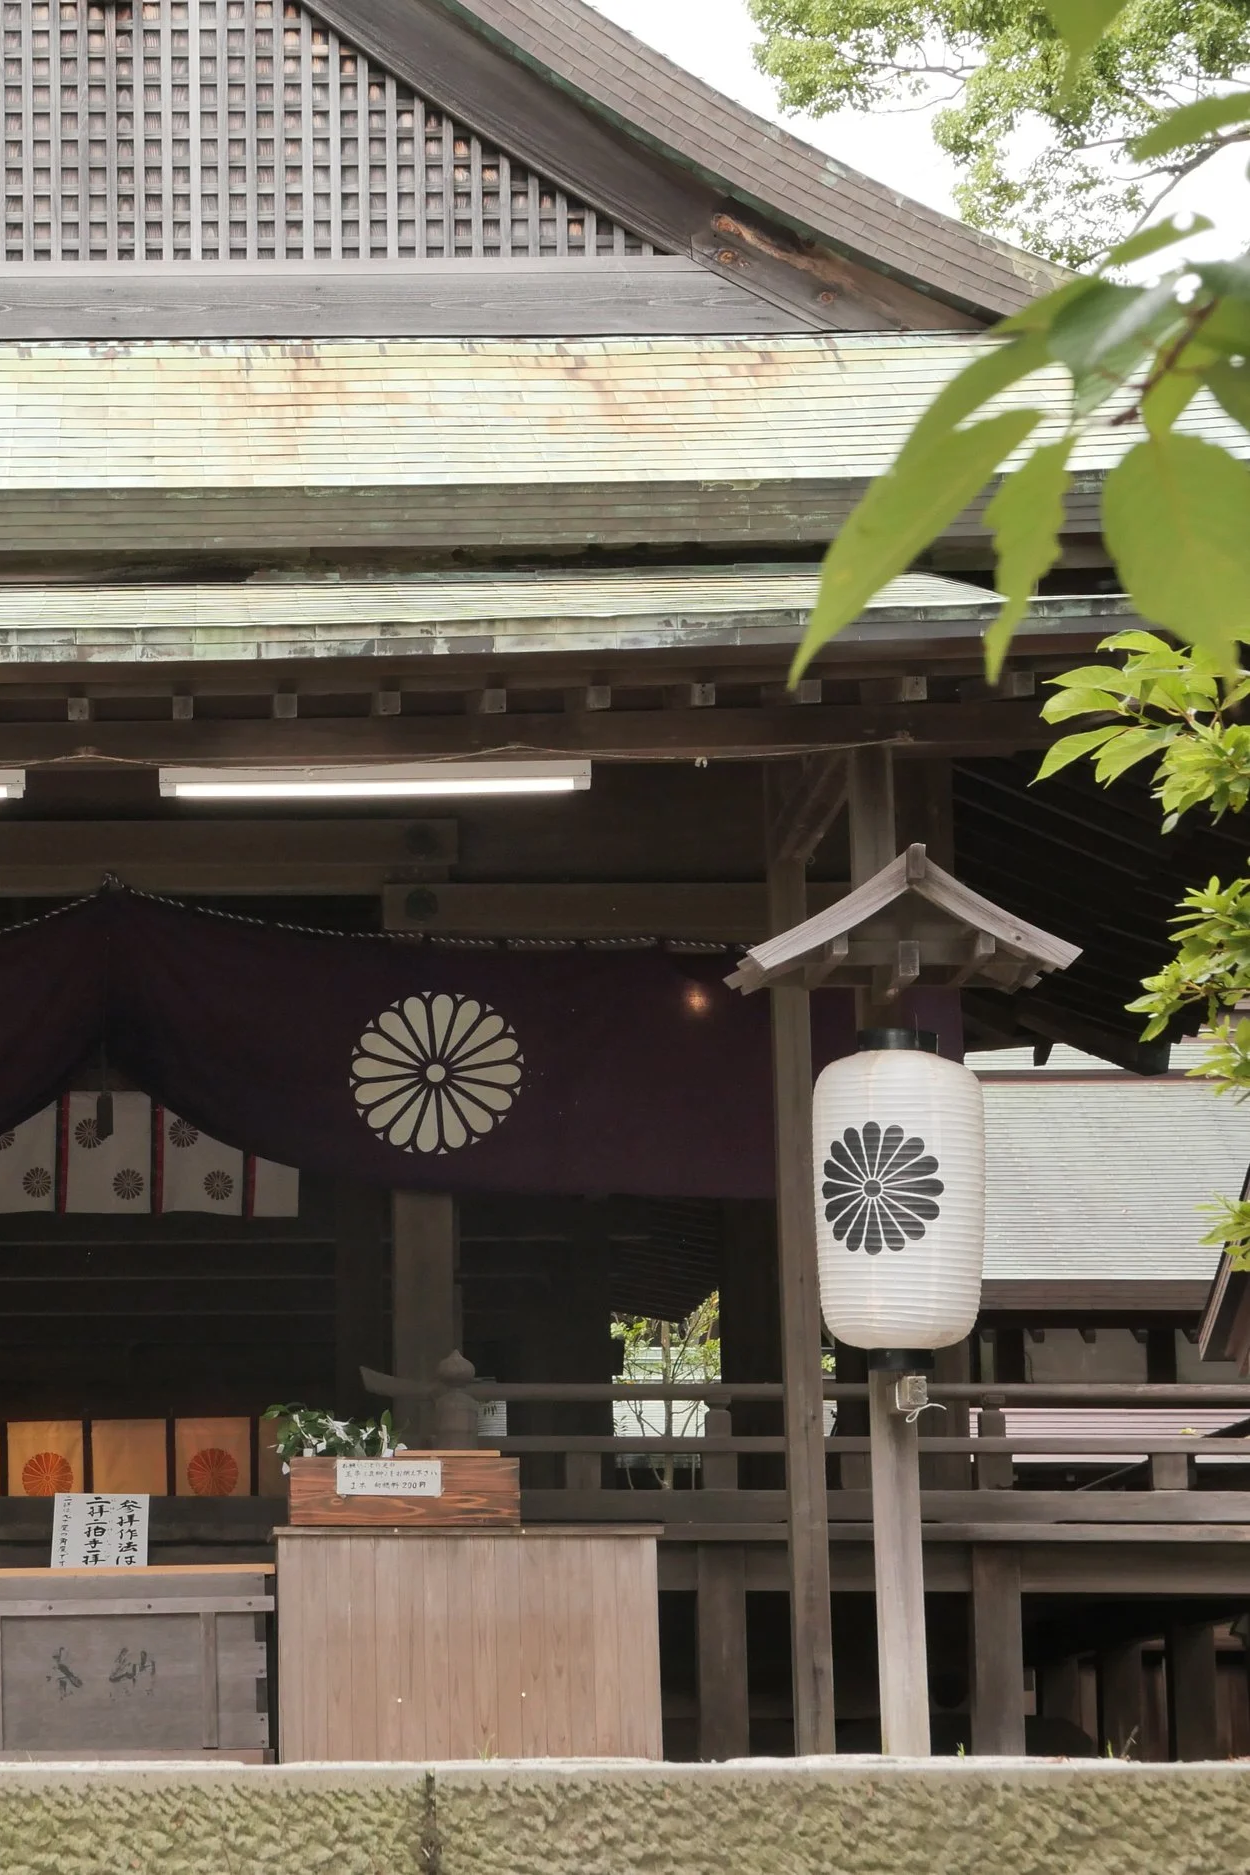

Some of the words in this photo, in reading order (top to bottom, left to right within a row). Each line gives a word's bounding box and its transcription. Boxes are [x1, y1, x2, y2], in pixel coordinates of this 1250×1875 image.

[115, 1499, 142, 1566] 参拝作法は
